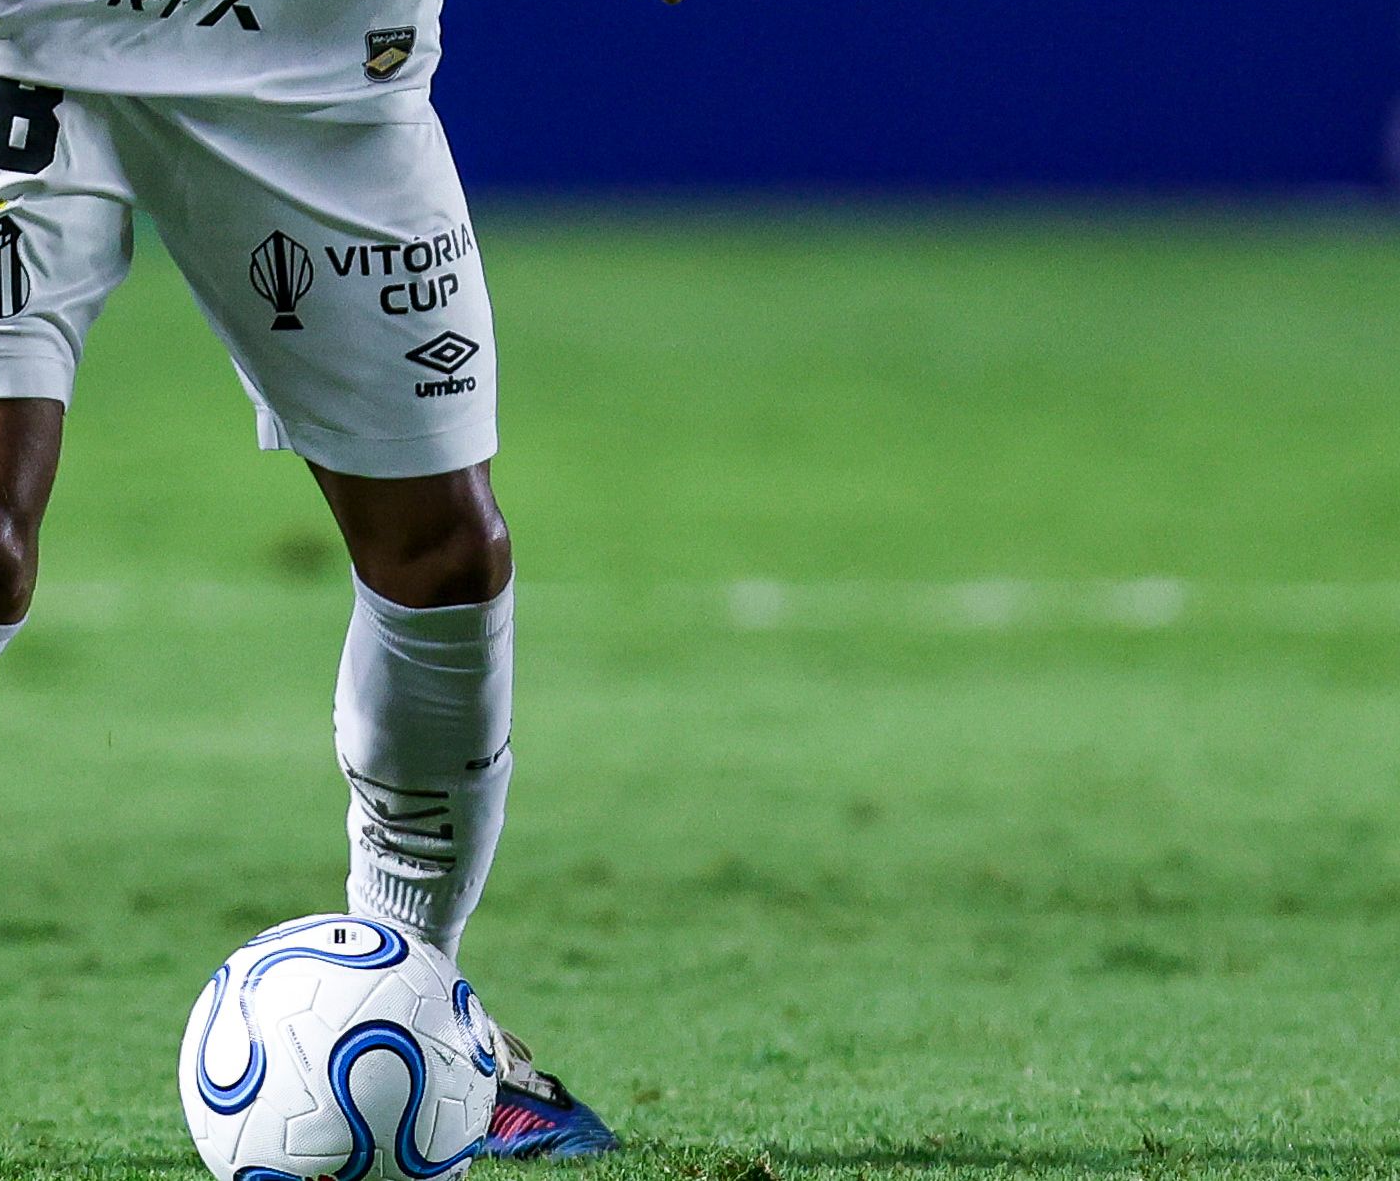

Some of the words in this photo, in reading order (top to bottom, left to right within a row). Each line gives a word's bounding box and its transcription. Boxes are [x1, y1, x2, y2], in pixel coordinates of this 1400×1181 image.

[324, 223, 473, 277] VITÓRIA
[380, 273, 458, 315] CUP
[415, 375, 476, 398] umbro
